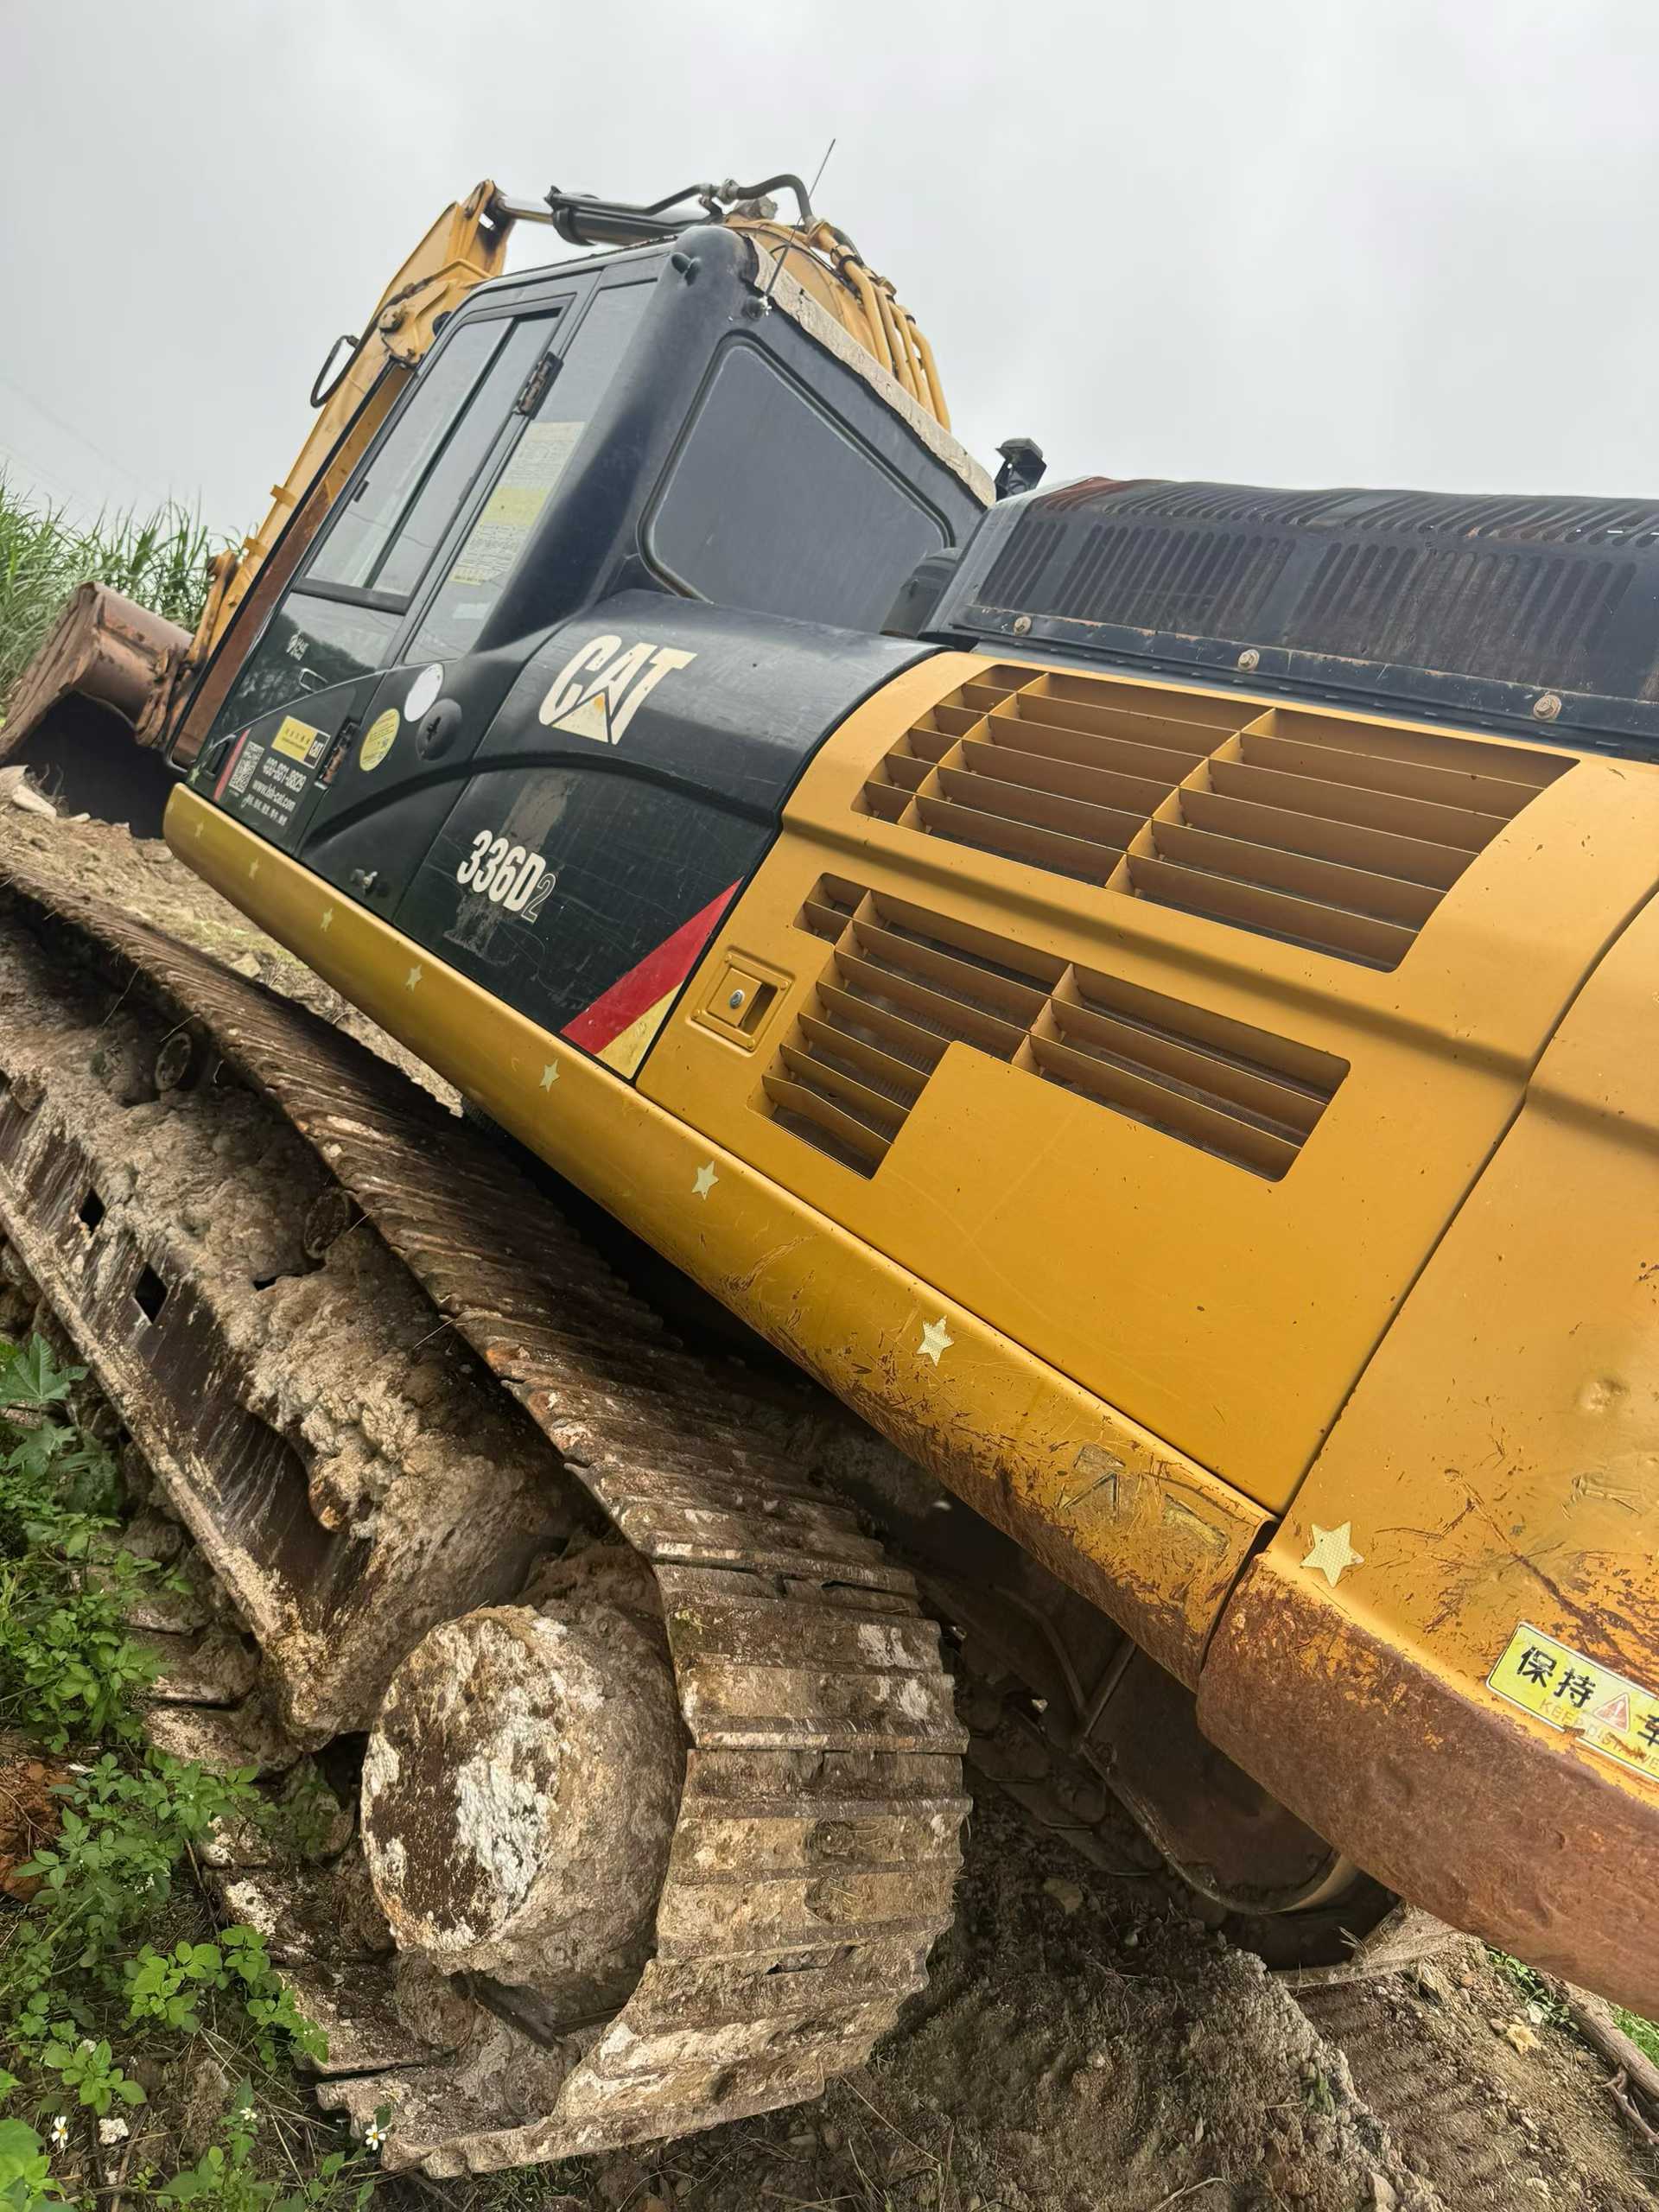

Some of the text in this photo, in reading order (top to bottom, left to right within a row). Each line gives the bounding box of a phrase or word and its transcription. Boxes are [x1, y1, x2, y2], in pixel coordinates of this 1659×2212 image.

[539, 635, 697, 745] CAT
[308, 740, 325, 758] CAT
[1517, 1645, 1596, 1708] 保持
[1540, 1699, 1584, 1727] KEEP
